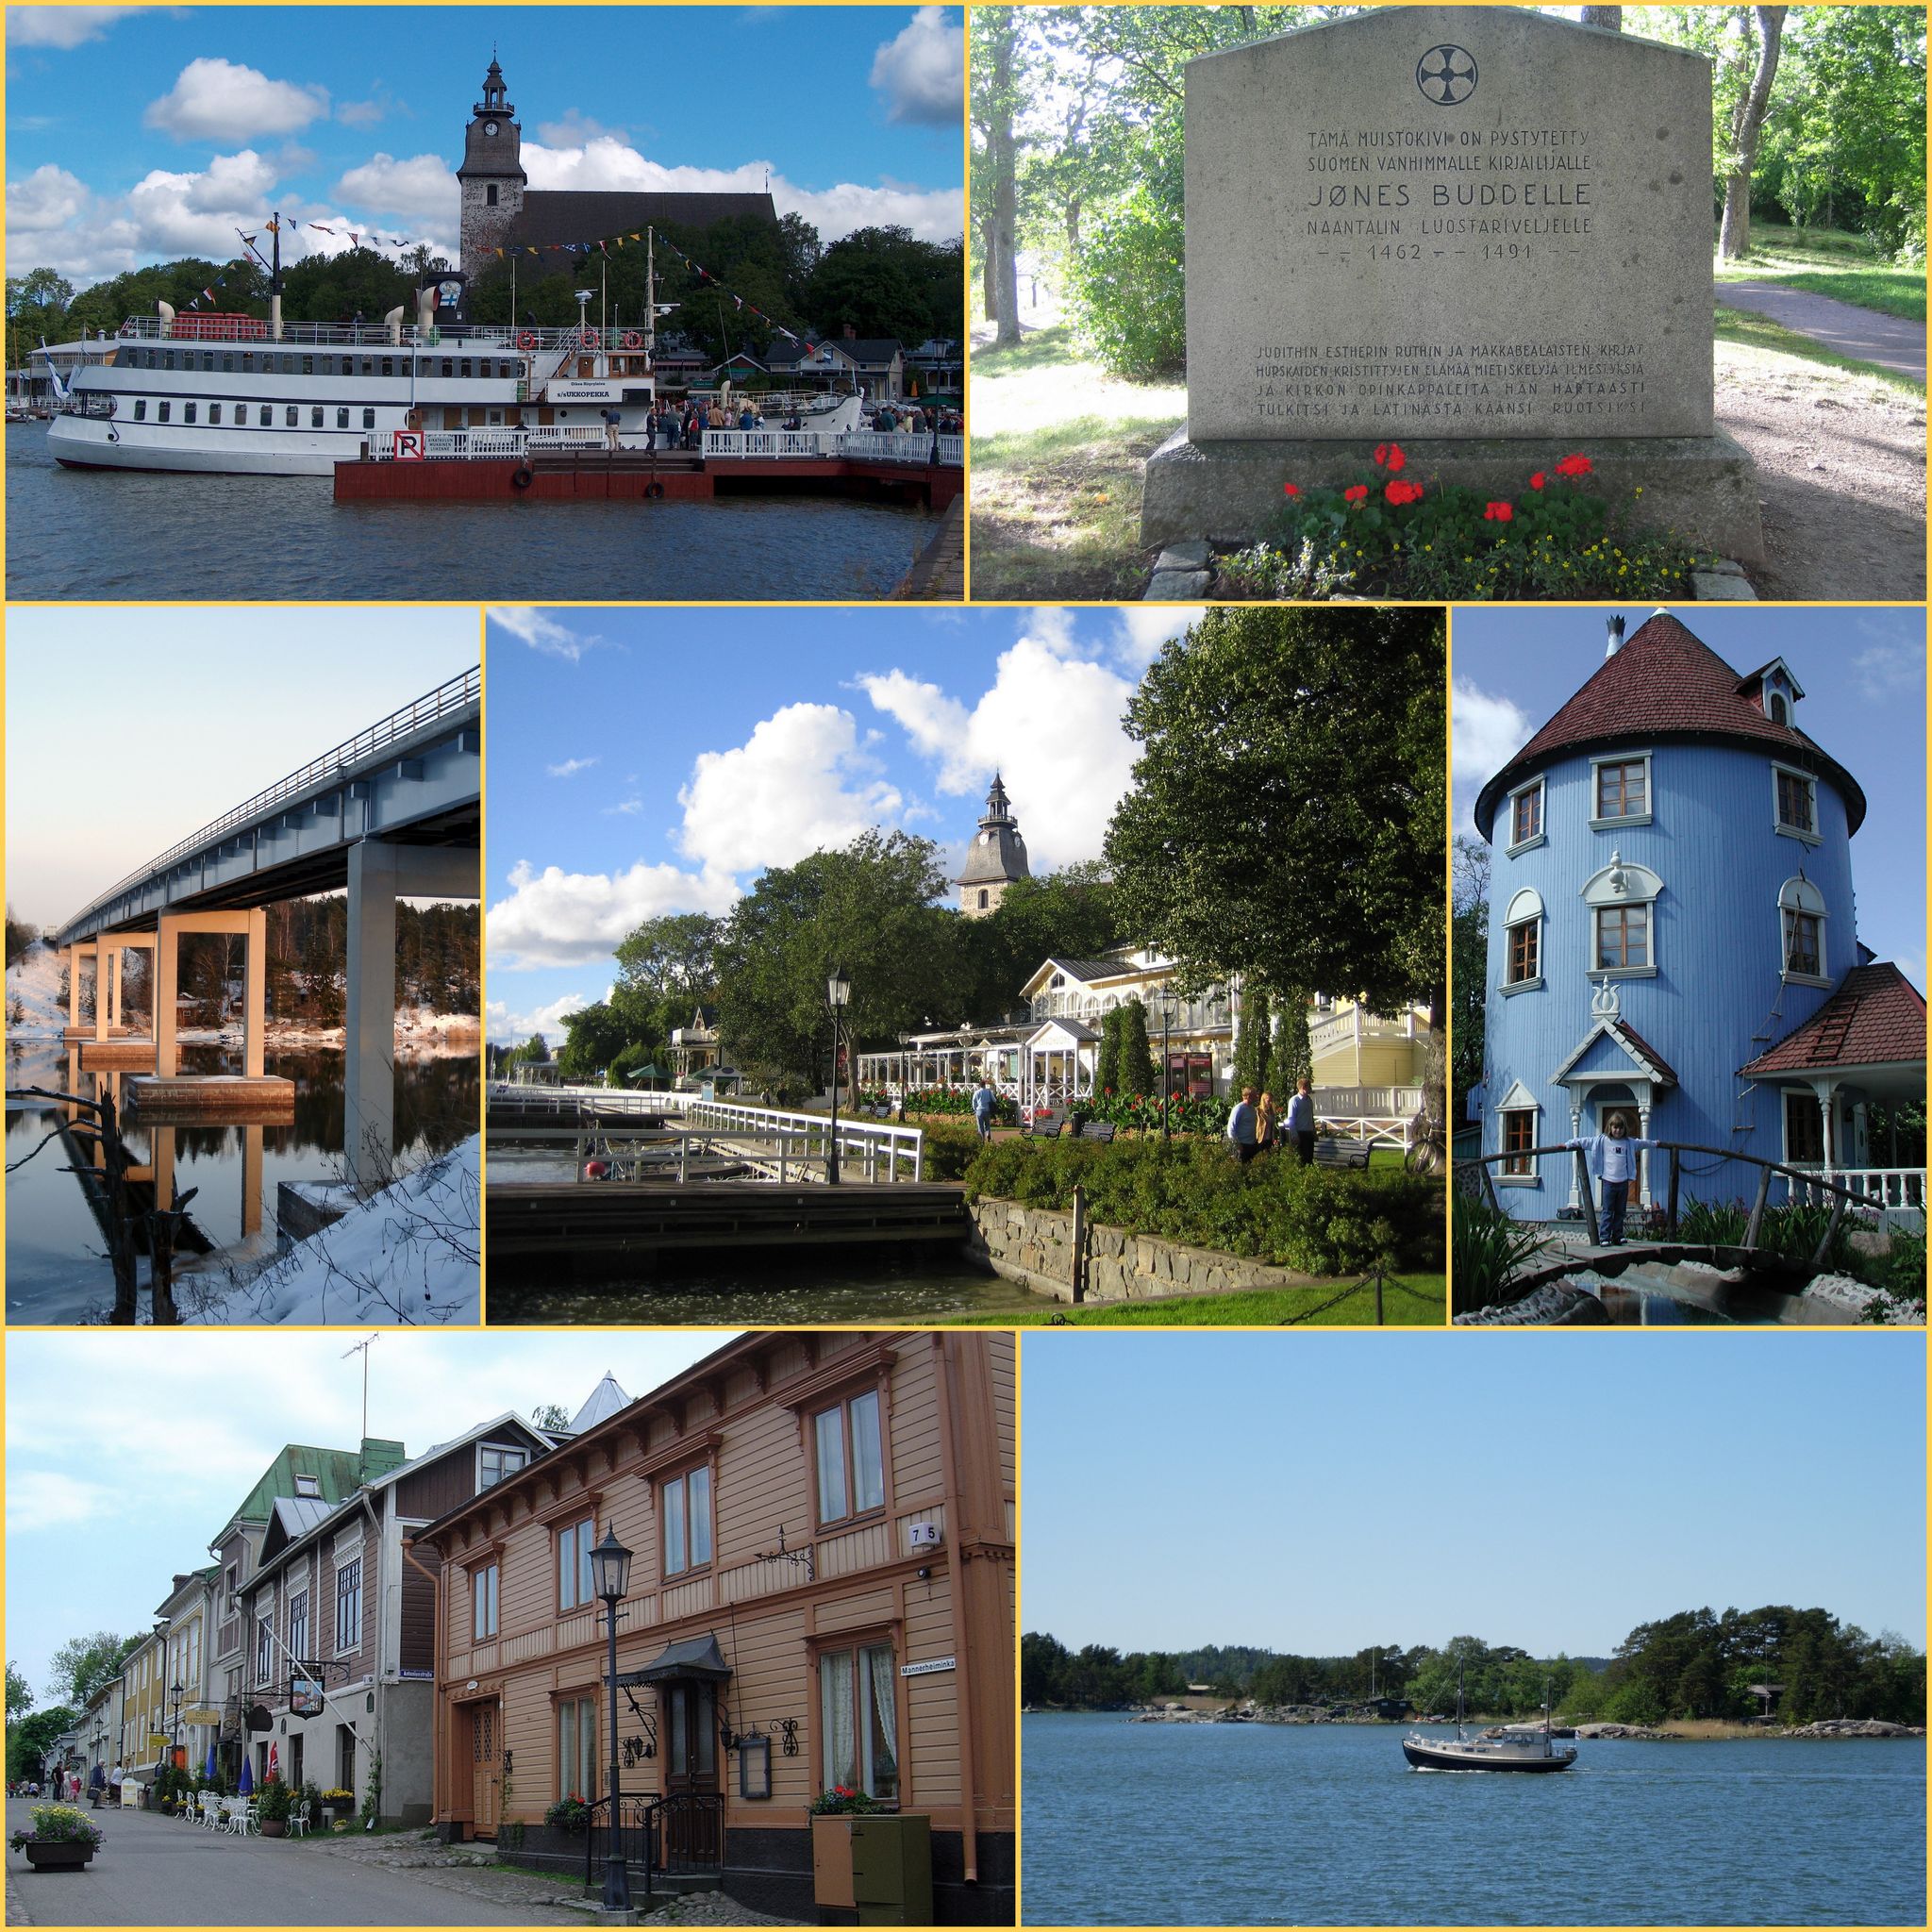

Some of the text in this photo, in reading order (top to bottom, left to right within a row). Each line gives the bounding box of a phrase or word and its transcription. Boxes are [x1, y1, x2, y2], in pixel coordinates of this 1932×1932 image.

[1307, 129, 1590, 148] TÄMÄ MUISTOKIVI ON PYSTYTETTY
[1307, 155, 1591, 172] SUOMEN VANHIMMALLE KIRJAILIJALLE
[1307, 183, 1591, 207] JØNES BUDDELLE
[1307, 218, 1591, 235] NAANTALIN LUOSTARIVELJELLE
[1368, 243, 1531, 259] 1462 1491
[1256, 343, 1643, 359] JUDITHIN ESTHERIN RUTHIN JA MAKKABEALAISTEN KIRJAT
[1256, 365, 1328, 377] HURSKAIDEN
[1334, 364, 1419, 377] KRISTITTYJEN
[1256, 384, 1274, 397] JA
[1286, 384, 1346, 396] KIRKON
[1358, 383, 1490, 396] OPINKAPPALEITA
[1553, 381, 1644, 395] HARTAASTI
[1257, 404, 1329, 416] TULKITSI
[1341, 404, 1359, 416] JA
[1374, 403, 1462, 416] LATINASTA
[1553, 401, 1644, 414] RUOTSIKSI
[912, 1529, 920, 1541] 7
[928, 1526, 936, 1539] 5
